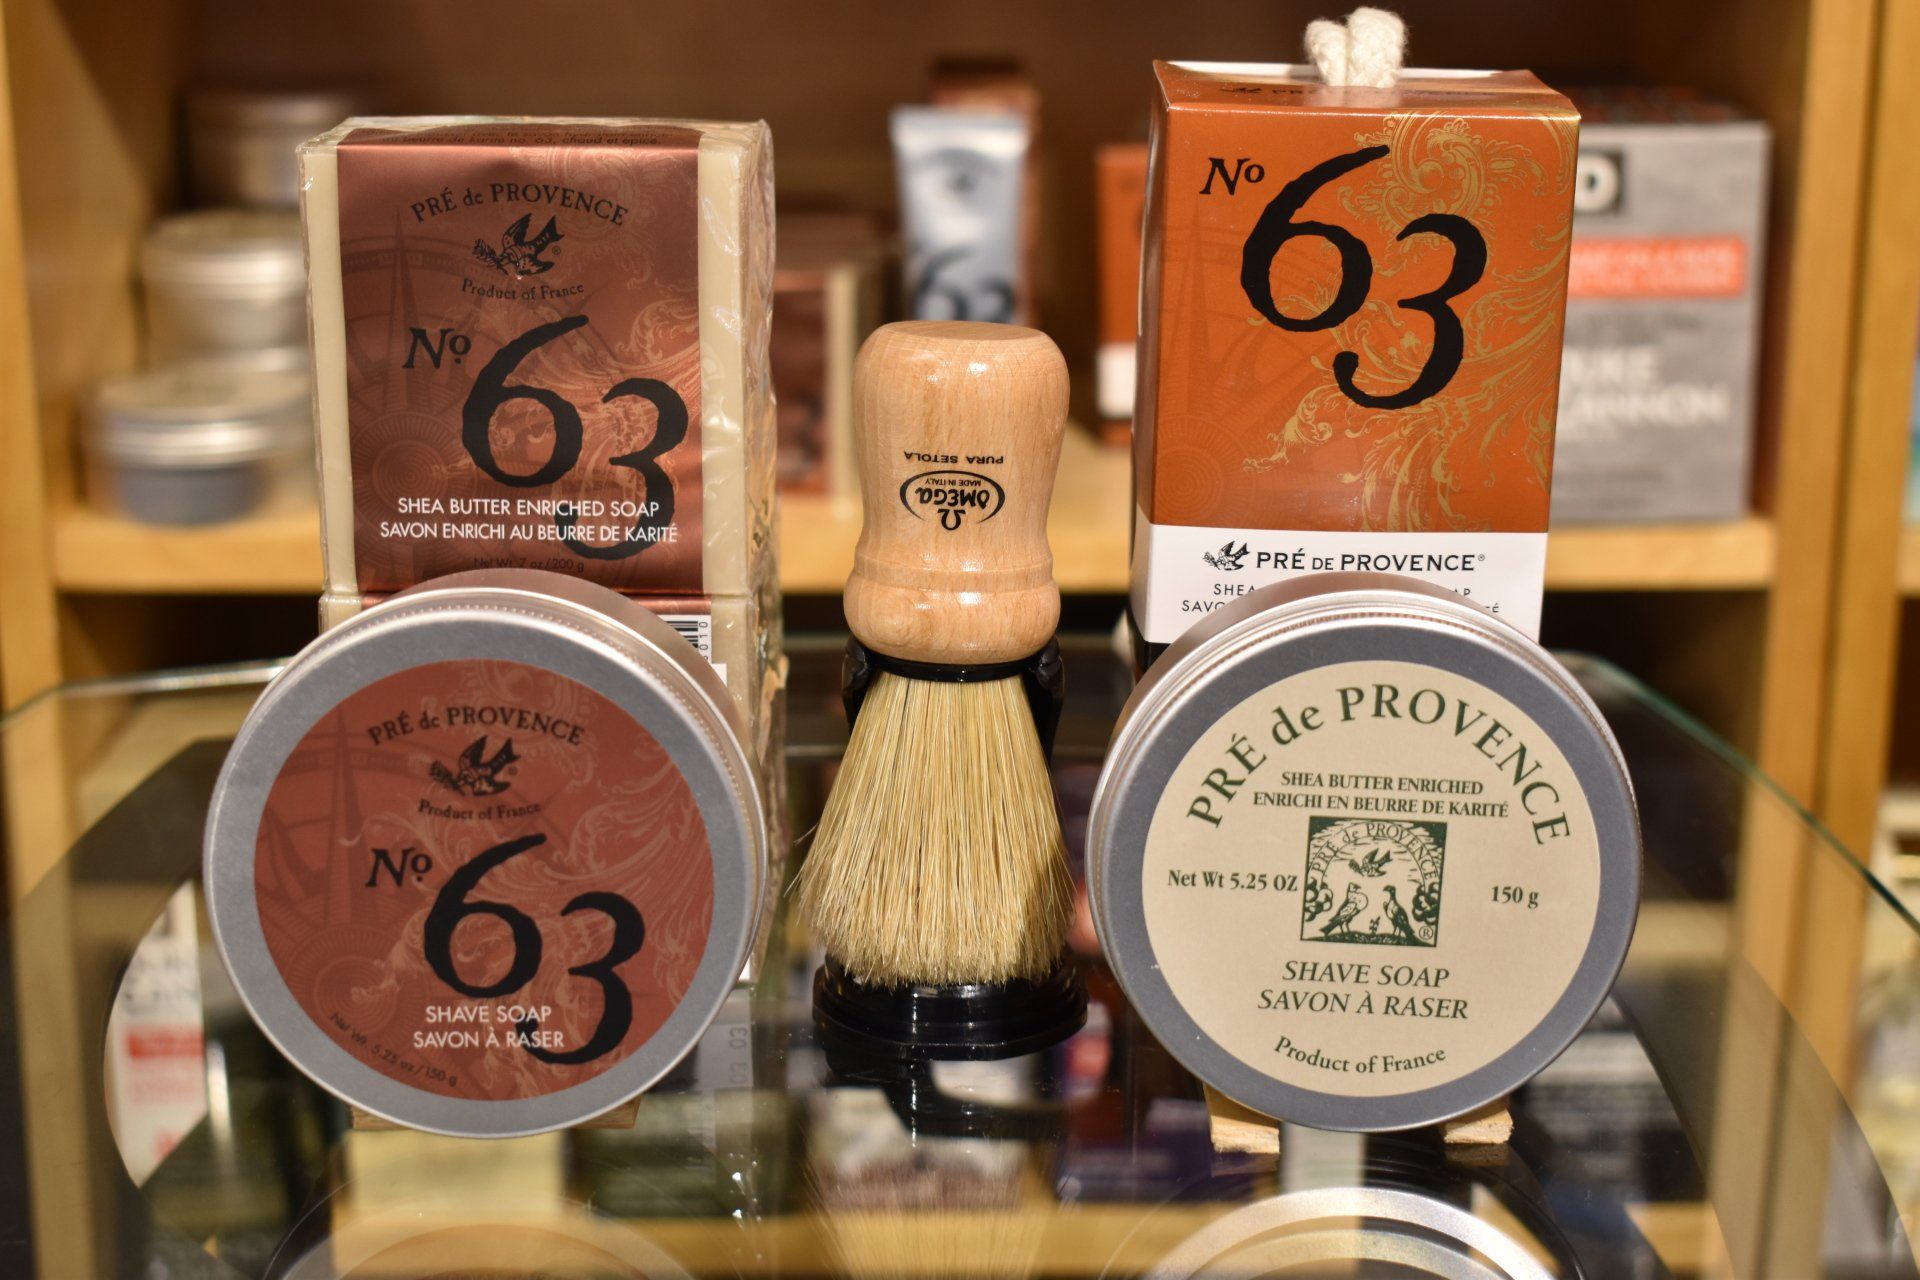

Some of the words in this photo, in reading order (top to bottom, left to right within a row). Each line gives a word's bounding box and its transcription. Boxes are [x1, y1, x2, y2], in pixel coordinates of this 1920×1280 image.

[411, 186, 457, 222] PRÉ
[463, 187, 483, 206] de
[491, 183, 629, 226] PROVENCE
[461, 277, 516, 299] Product
[522, 286, 536, 300] of
[541, 282, 584, 300] France
[1240, 144, 1488, 410] 63
[462, 314, 689, 560] 63
[903, 451, 959, 464] SETOLA
[965, 455, 1004, 465] PURA
[924, 477, 947, 486] ITALY
[958, 479, 982, 487] MADE
[397, 497, 445, 514] SHEA
[450, 498, 511, 516] BUTTER
[516, 499, 606, 517] ENRICHED
[610, 500, 660, 518] SOAP
[380, 521, 438, 538] SAVON
[442, 522, 505, 540] ENRICHI
[509, 523, 534, 540] AU
[537, 524, 596, 541] BEURRE
[599, 525, 621, 542] DE
[624, 522, 678, 543] KARITÉ
[518, 557, 527, 568] 7
[577, 561, 585, 573] g
[1255, 547, 1306, 570] PRÉ
[1311, 557, 1335, 571] DE
[367, 709, 414, 746] PRÉ
[419, 710, 441, 731] de
[446, 706, 585, 746] PROVENCE
[1186, 732, 1267, 829] PRÉ
[1271, 705, 1324, 746] de
[1336, 683, 1571, 846] PROVENCE
[1280, 771, 1324, 787] SHEA
[1328, 773, 1393, 791] BUTTER
[1397, 777, 1484, 795] ENRICHED
[418, 799, 473, 820] Product
[478, 806, 492, 821] of
[497, 803, 541, 820] France
[1252, 791, 1322, 809] ENRICHI
[1327, 794, 1349, 811] EN
[1353, 796, 1418, 814] BEURRE
[1421, 799, 1445, 815] DE
[1448, 800, 1509, 818] KARITÉ
[1342, 829, 1359, 844] de
[1365, 823, 1439, 881] PROVENCE
[1167, 868, 1197, 887] Net
[1201, 870, 1225, 888] Wt
[1229, 872, 1268, 892] 5.25
[1490, 885, 1523, 903] 150
[1528, 890, 1540, 909] g
[423, 832, 646, 1065] 63
[1282, 960, 1371, 984] SHAVE
[1377, 965, 1450, 988] SOAP
[425, 1005, 490, 1023] SHAVE
[496, 1005, 552, 1023] SOAP
[1257, 988, 1351, 1013] SAVON
[1355, 990, 1375, 1015] À
[1382, 995, 1469, 1020] RASER
[330, 1011, 351, 1032] Net
[413, 1030, 480, 1048] SAVON
[485, 1026, 500, 1048] À
[506, 1030, 564, 1048] RASER
[1273, 1034, 1350, 1072] Product
[1355, 1055, 1378, 1074] of
[1382, 1049, 1447, 1073] France
